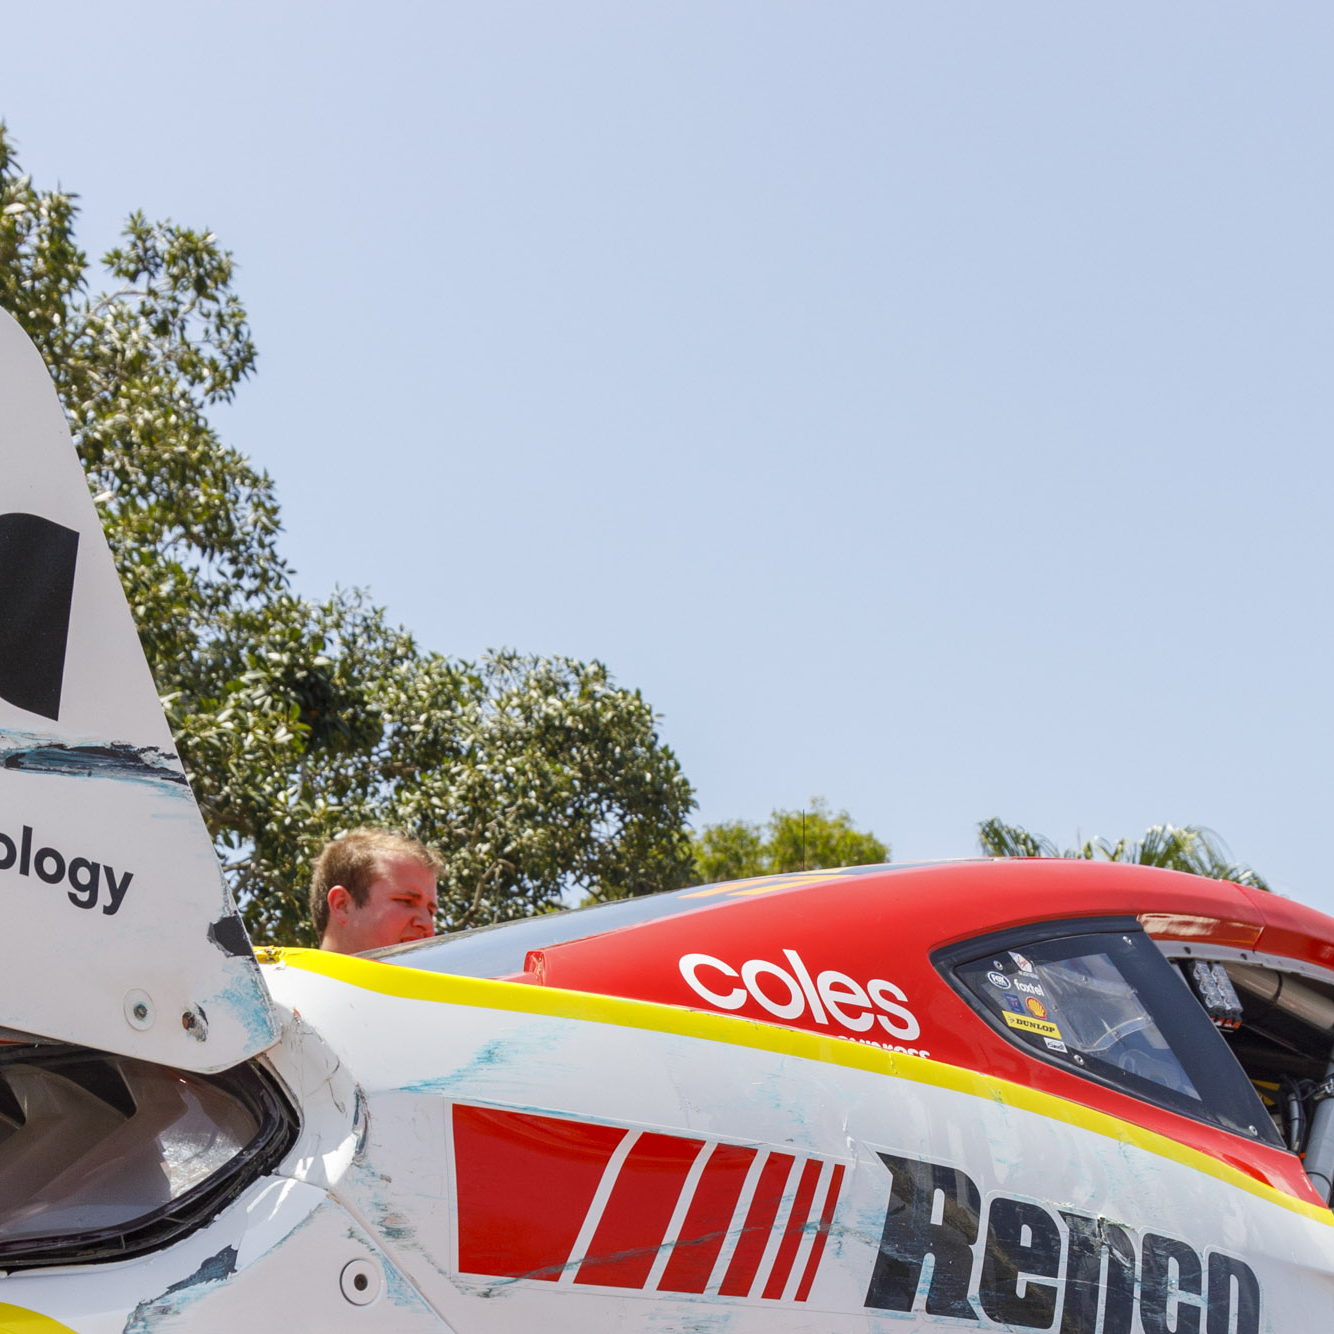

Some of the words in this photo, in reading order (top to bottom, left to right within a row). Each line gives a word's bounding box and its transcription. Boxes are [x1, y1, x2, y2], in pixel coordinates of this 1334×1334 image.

[679, 948, 920, 1041] coles
[1013, 978, 1045, 997] foxtel
[1016, 1018, 1056, 1033] DUNLOP
